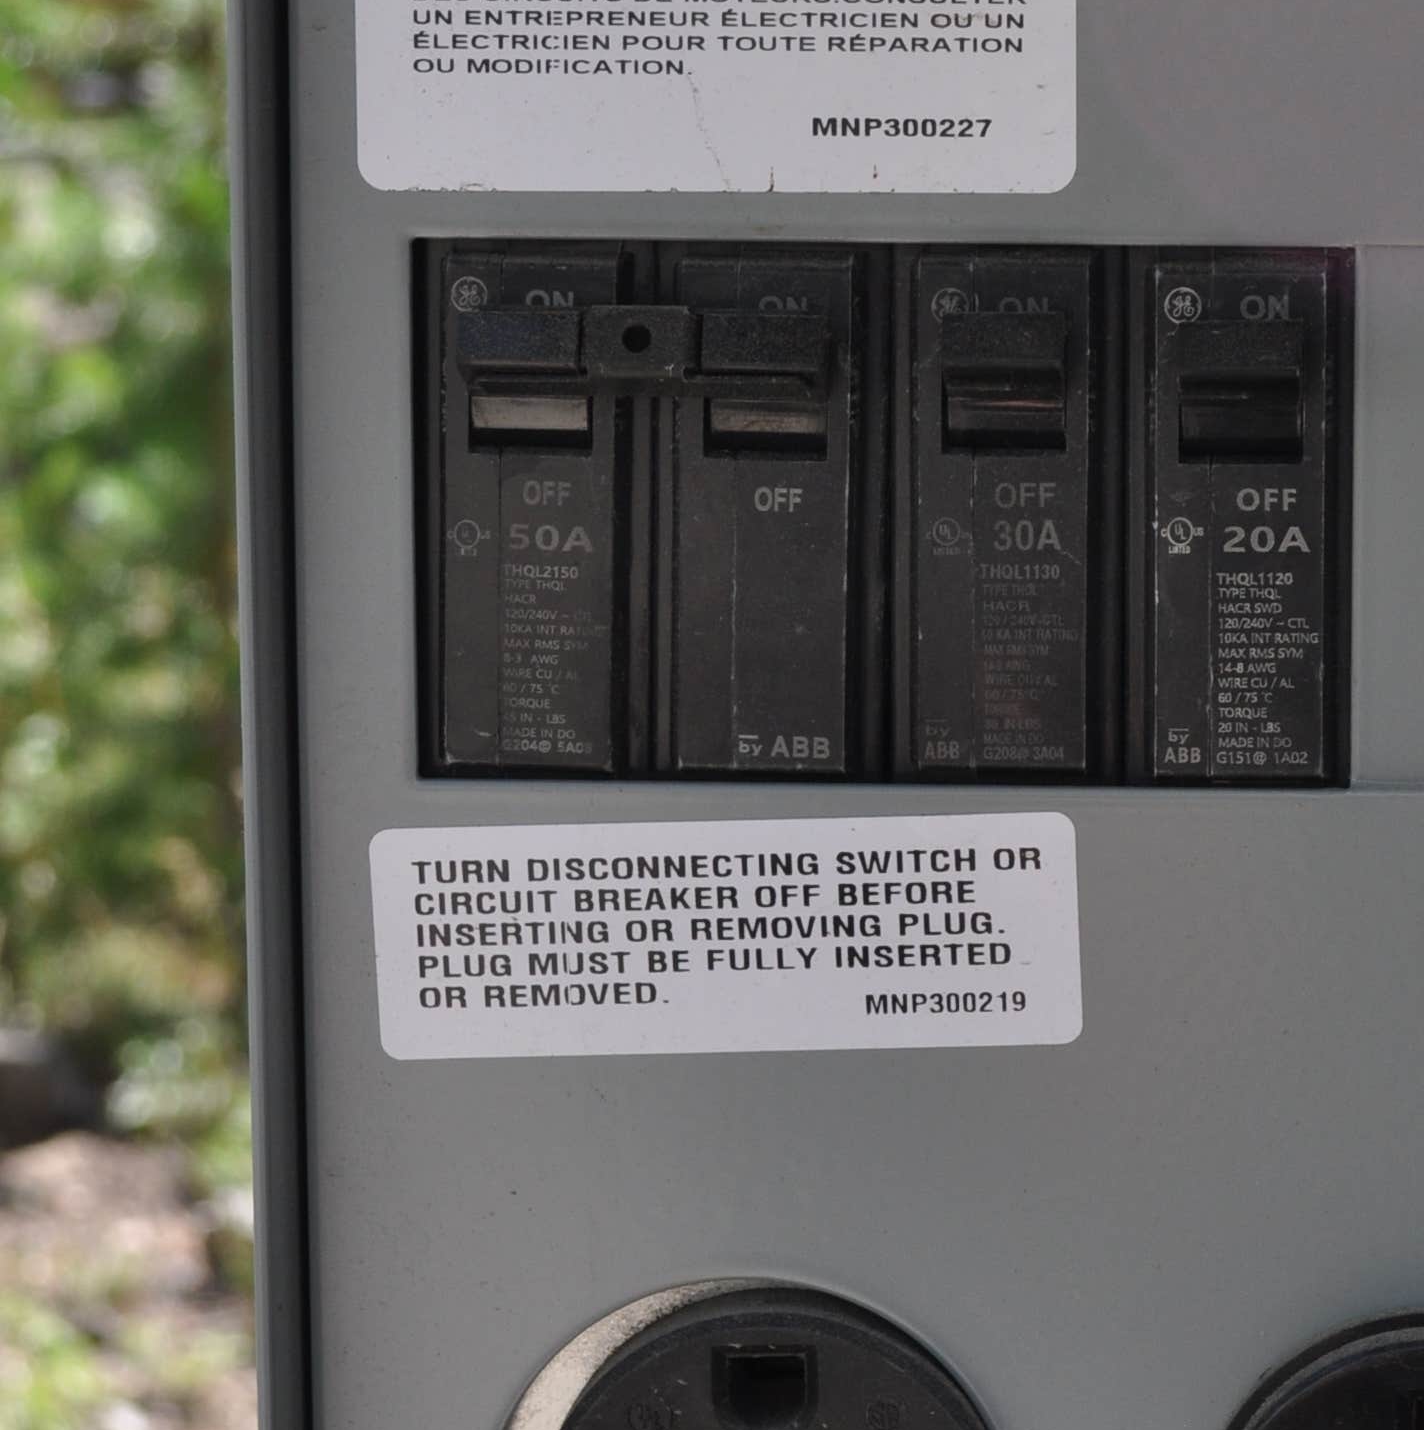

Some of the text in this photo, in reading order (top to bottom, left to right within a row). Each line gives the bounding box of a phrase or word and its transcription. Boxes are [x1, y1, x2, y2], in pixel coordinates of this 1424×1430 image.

[412, 58, 692, 76] OU MODIFICATION.
[812, 117, 993, 138] MNP300227
[1239, 294, 1290, 320] ON
[522, 479, 573, 507] OFF
[754, 487, 803, 513] OFF
[995, 481, 1057, 509] OFF
[1236, 487, 1297, 512] OFF
[509, 522, 593, 553] 50A
[993, 519, 1062, 552] 30A
[1222, 525, 1312, 554] 20A
[503, 563, 580, 580] THQL2150
[979, 563, 1061, 580] THQL1130
[1216, 572, 1294, 587] THQL1120
[1218, 587, 1282, 600] TYPE THQL
[1218, 602, 1283, 614] HACR SWD
[1218, 616, 1310, 630] 120/240V CTL
[1218, 632, 1320, 644] 10KA INT RATING
[1218, 706, 1269, 720] TORQUE
[739, 734, 831, 760] by ABB
[923, 740, 961, 761] ABB
[1167, 731, 1190, 745] by
[1218, 736, 1255, 748] MADE
[1256, 736, 1271, 748] IN
[1164, 746, 1202, 764] ABB
[411, 847, 1041, 885] TURN DISCONNECTING SWITCH OR
[414, 880, 976, 916] CIRCUIT BREAKER OFF BEFORE
[416, 911, 1005, 948] INSERTING OR REMOVING PLUG.
[418, 942, 1012, 979] PLUG MUST BE FULLY INSERTED
[419, 981, 669, 1009] OR REMOVED.
[865, 990, 1026, 1015] MNP300219
